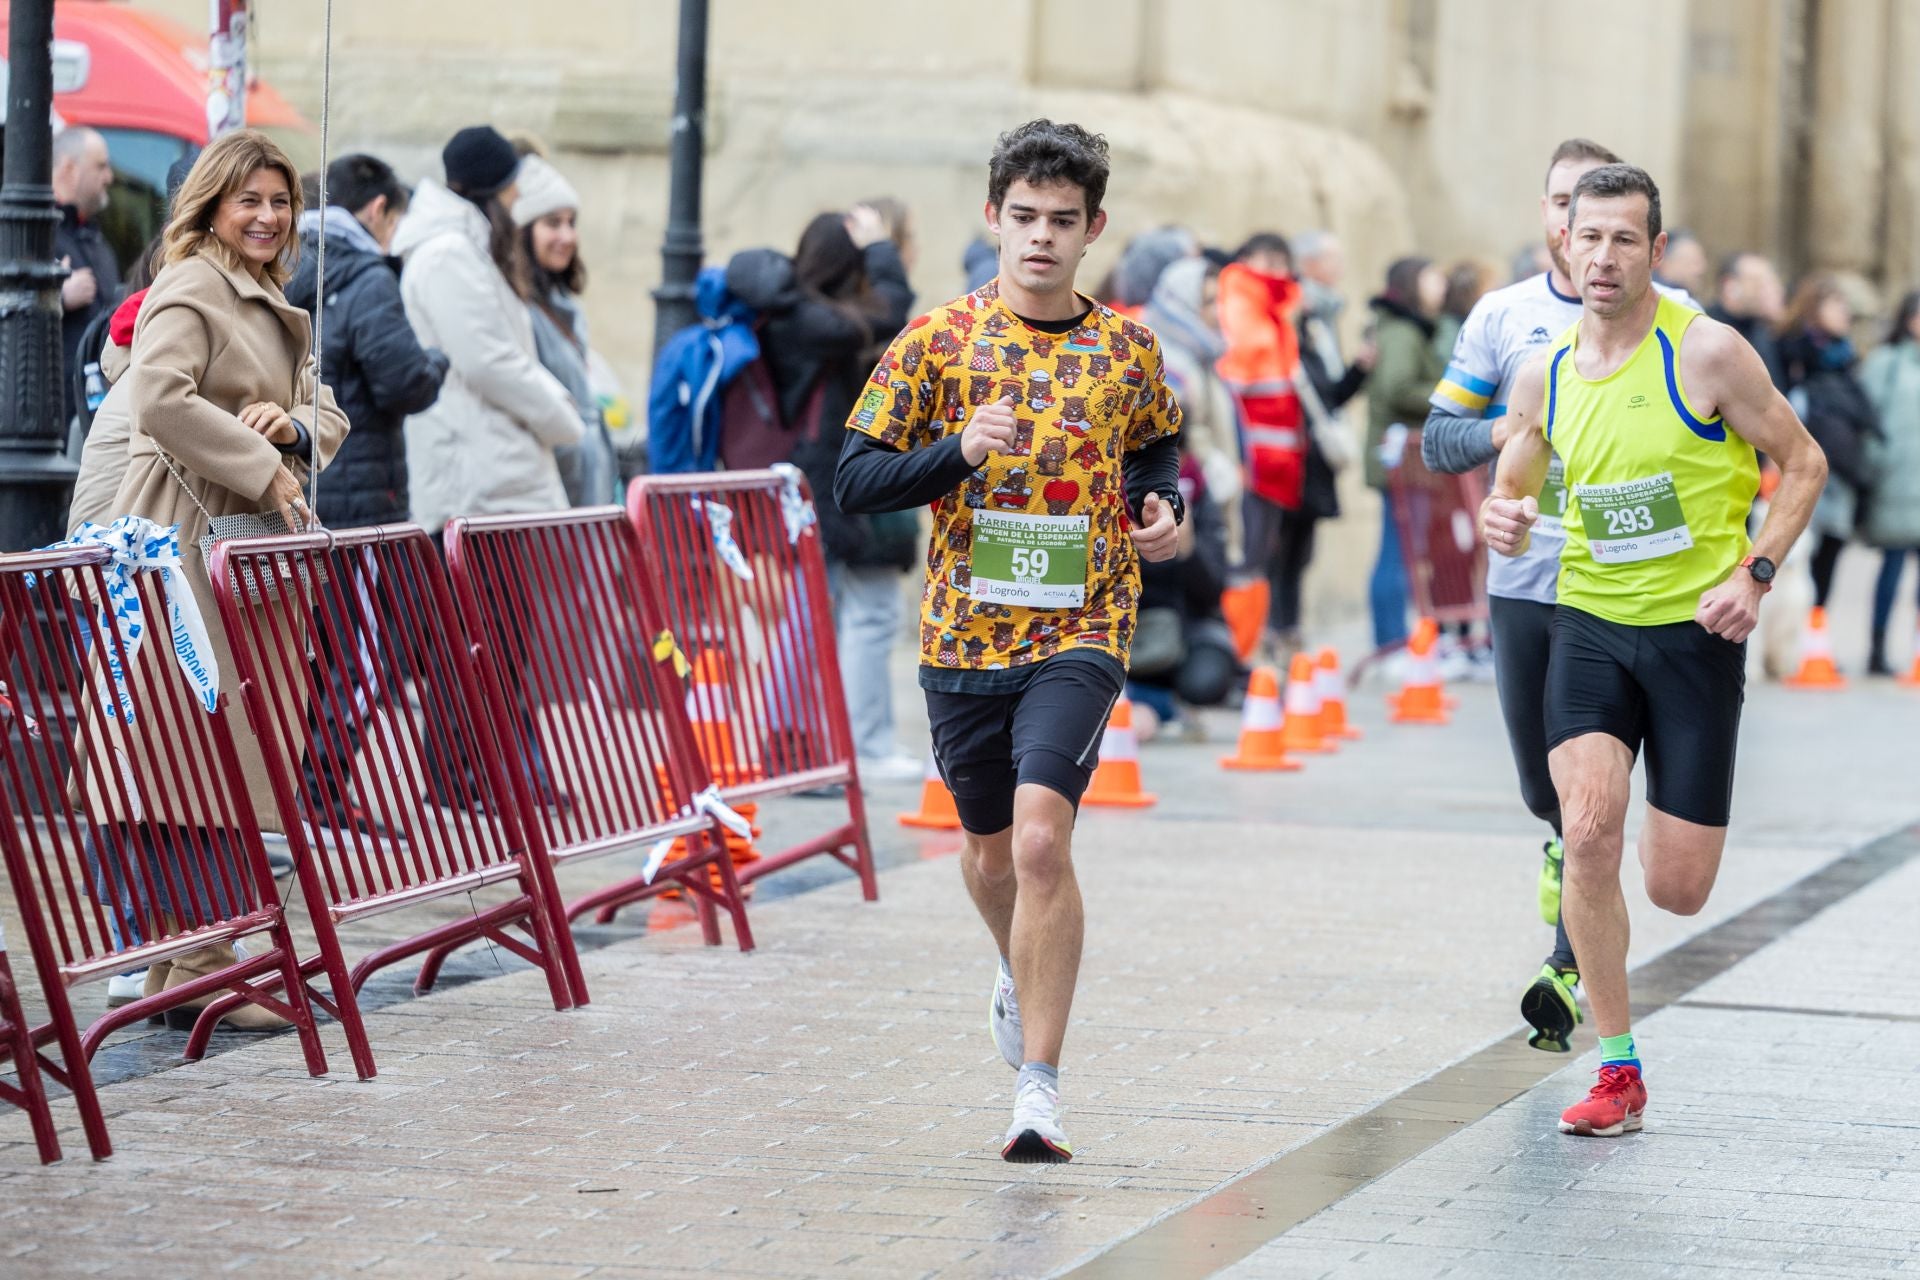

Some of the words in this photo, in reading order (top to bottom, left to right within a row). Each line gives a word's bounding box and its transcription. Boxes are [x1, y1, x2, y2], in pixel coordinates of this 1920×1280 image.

[1620, 476, 1669, 493] POPULAR
[1626, 486, 1670, 500] ESPERANZA
[978, 517, 1031, 531] CARRERA
[1034, 523, 1086, 532] POPULAR
[1603, 505, 1654, 535] 293
[980, 527, 1009, 537] VIRGEN
[997, 537, 1025, 545] PATRONA
[1604, 543, 1638, 553] Logroño
[1011, 547, 1050, 578] 59
[990, 585, 1030, 598] Logroño
